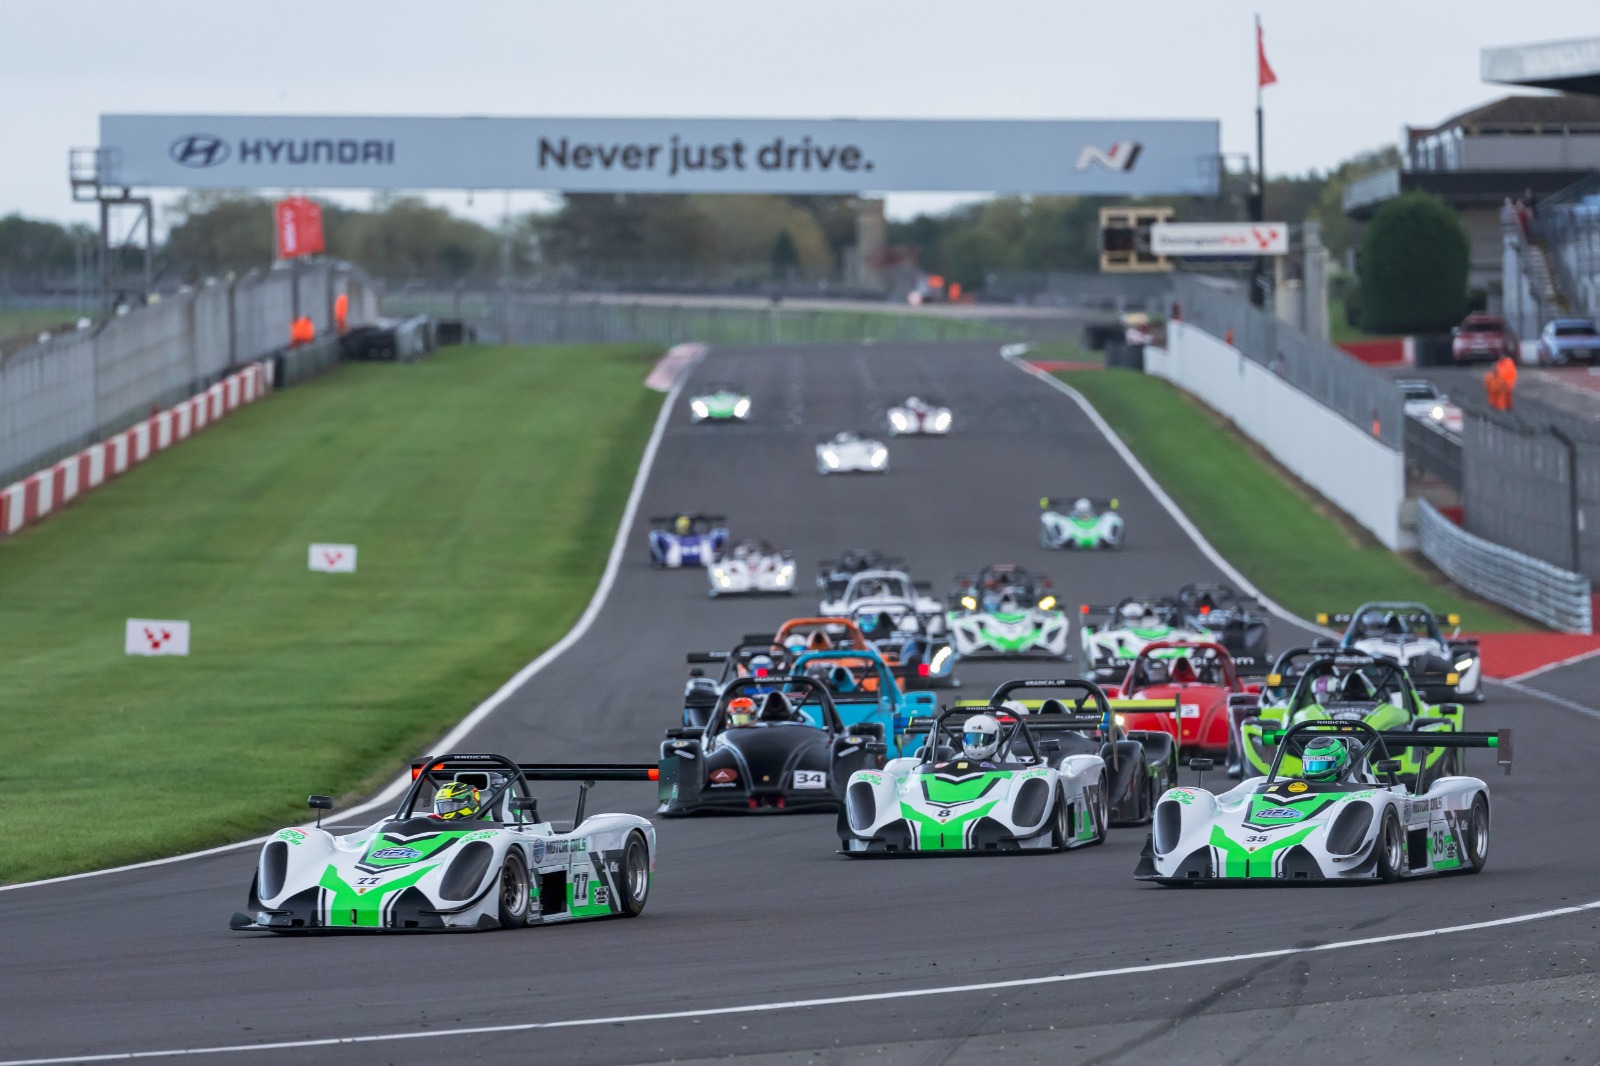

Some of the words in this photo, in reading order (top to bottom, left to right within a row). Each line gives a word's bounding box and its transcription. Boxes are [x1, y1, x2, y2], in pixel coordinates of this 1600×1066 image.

[238, 138, 396, 165] HYUNDAI
[537, 135, 662, 170] Never
[668, 133, 747, 177] just
[756, 135, 876, 172] drive.
[795, 772, 823, 784] 34
[937, 809, 952, 818] 8
[546, 839, 569, 854] MOTOR
[570, 837, 587, 852] OILS
[1246, 835, 1269, 843] 35
[1432, 829, 1444, 855] 35
[356, 877, 382, 885] 77
[574, 873, 588, 901] 77
